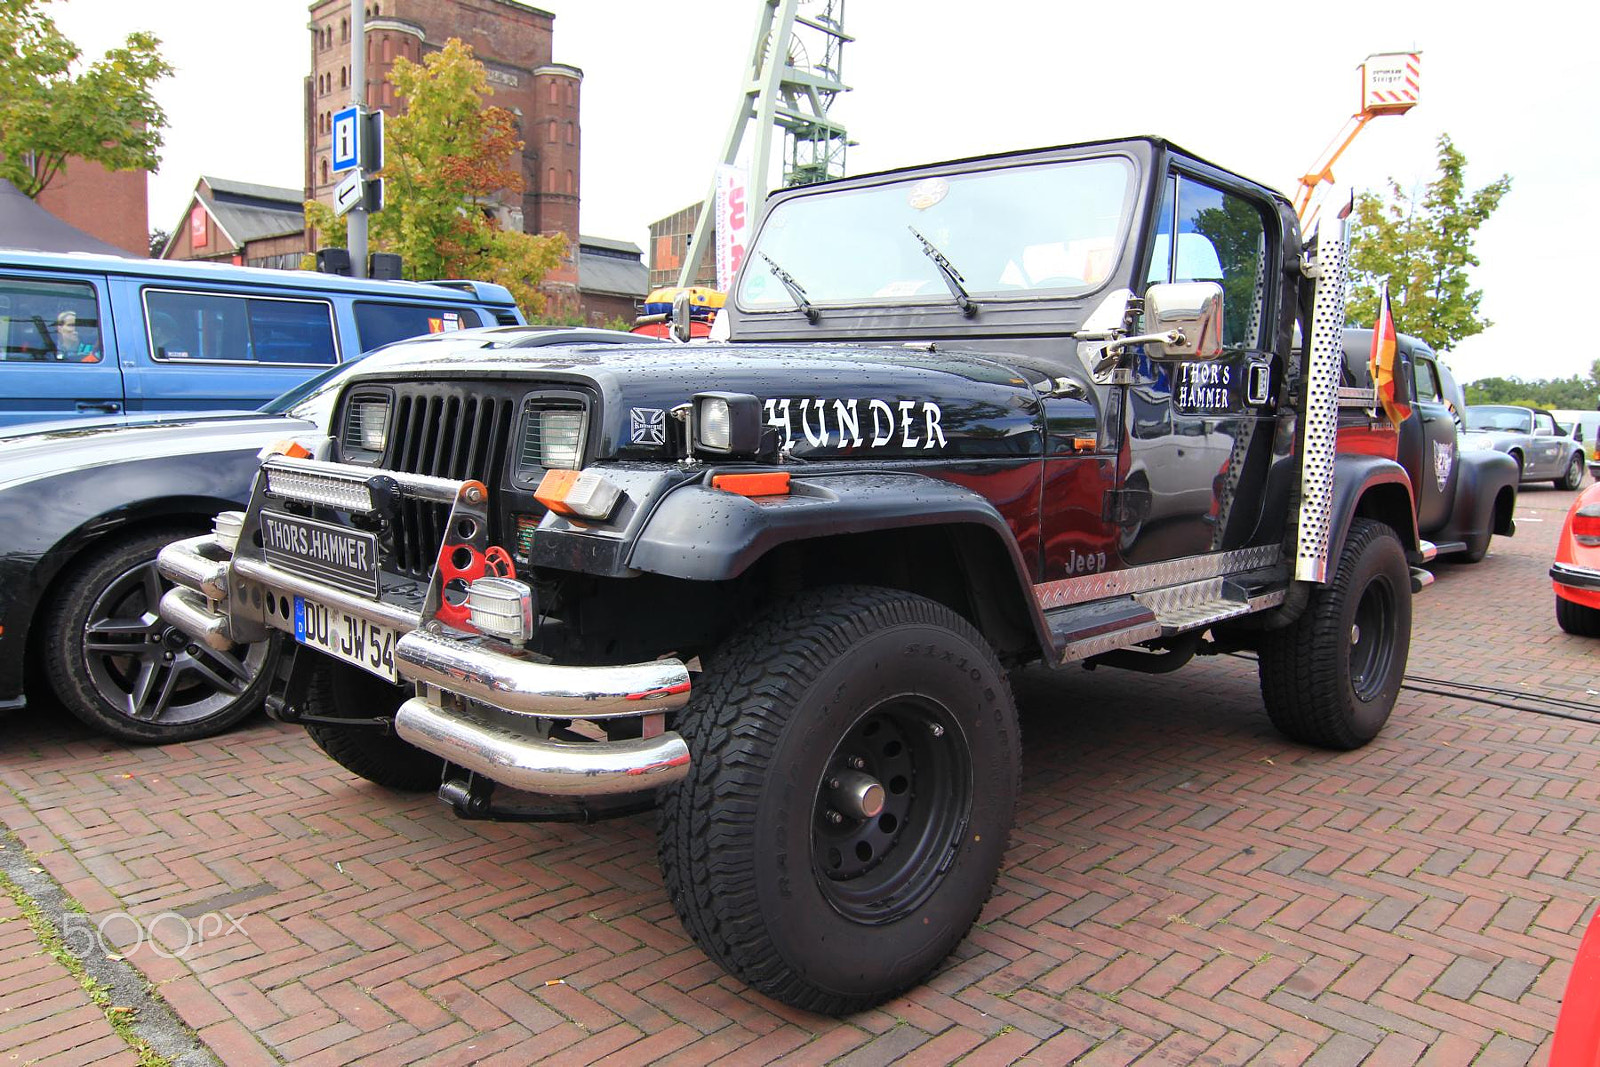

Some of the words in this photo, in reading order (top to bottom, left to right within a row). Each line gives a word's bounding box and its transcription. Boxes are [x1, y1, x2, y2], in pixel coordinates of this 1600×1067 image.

[1180, 362, 1230, 384] THOR'S
[1180, 386, 1229, 408] HAMMER
[1065, 550, 1106, 574] Jeep
[298, 622, 303, 633] D
[341, 615, 366, 662] JW
[370, 625, 394, 675] 54
